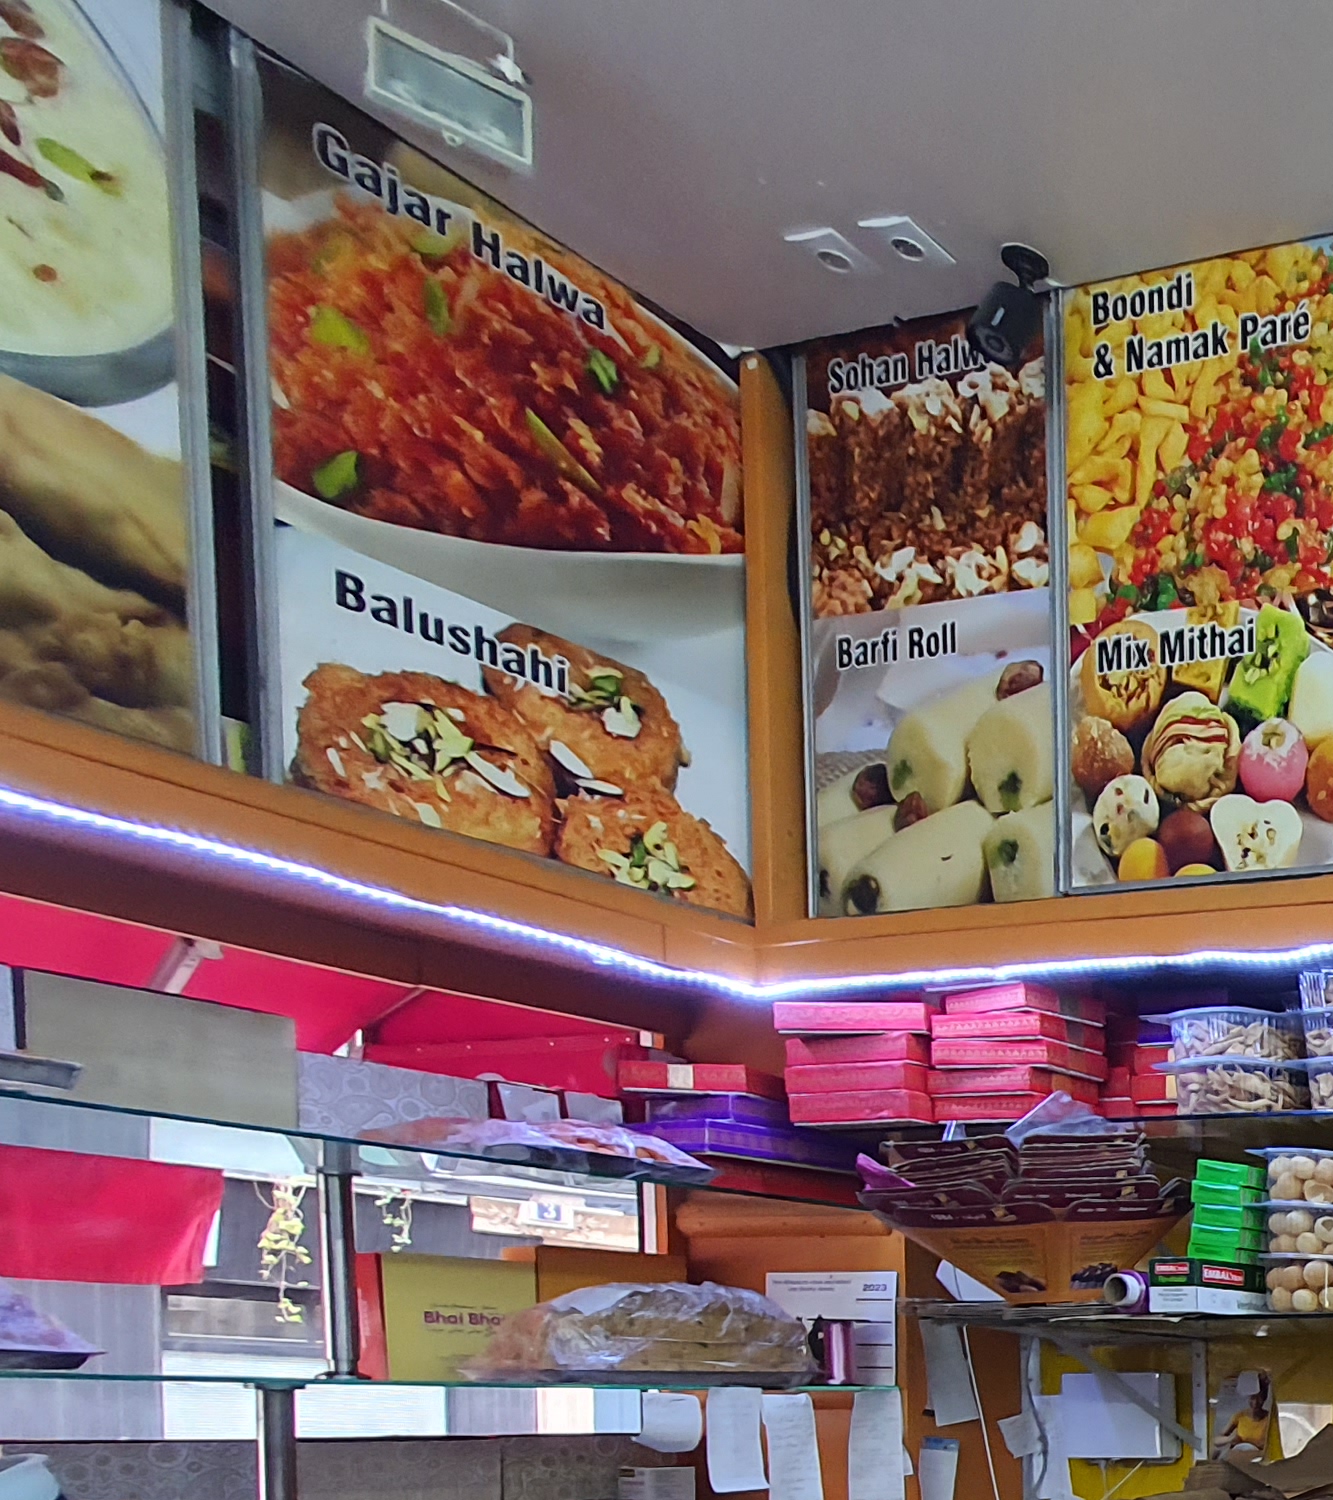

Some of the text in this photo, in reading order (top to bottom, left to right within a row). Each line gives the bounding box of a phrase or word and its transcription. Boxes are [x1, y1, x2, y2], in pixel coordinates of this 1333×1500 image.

[314, 126, 605, 330] Gajar Halwa
[1091, 272, 1193, 326] Boondi
[828, 335, 988, 394] Sohan Halw
[1093, 300, 1310, 379] & Namak Paré
[334, 569, 568, 694] Balushahi
[837, 621, 957, 669] Barfi Roll
[1097, 618, 1255, 673] Mix Mithai
[862, 1283, 888, 1292] 2023
[468, 1312, 504, 1326] Bha
